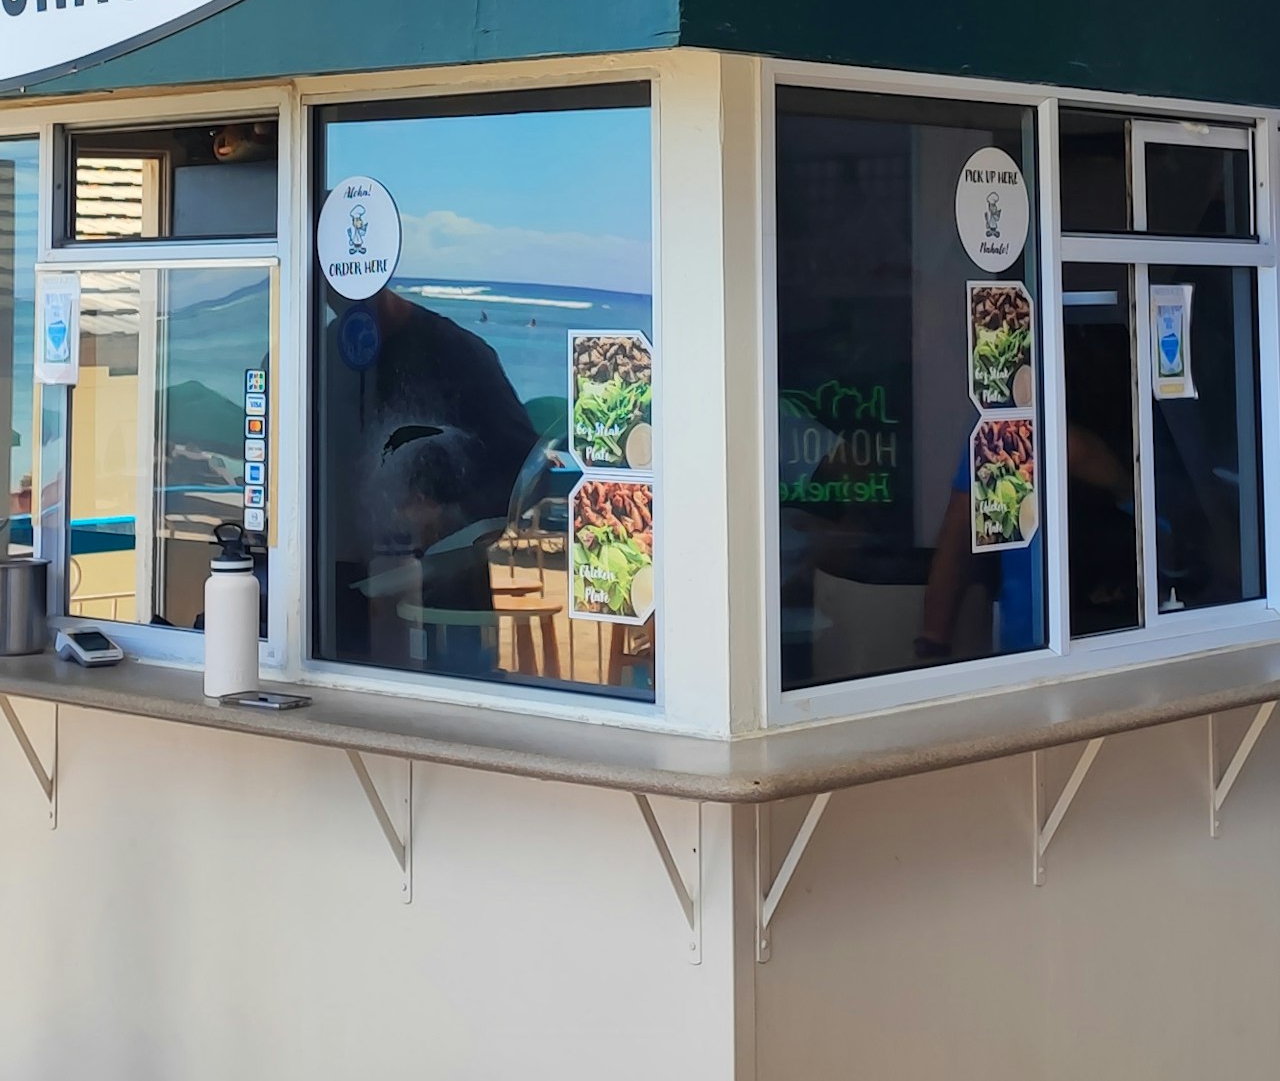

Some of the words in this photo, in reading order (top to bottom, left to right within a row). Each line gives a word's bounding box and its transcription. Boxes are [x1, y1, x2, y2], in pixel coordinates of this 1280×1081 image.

[965, 169, 984, 183] PICK
[985, 170, 996, 184] UP
[997, 171, 1018, 185] HERE
[344, 184, 372, 199] Aloha!
[980, 242, 1009, 255] Mahalo!
[329, 261, 362, 277] ORDER
[364, 258, 388, 274] HERE
[585, 445, 610, 462] Plate
[580, 564, 614, 581] Chicken
[585, 586, 610, 604] Plate
